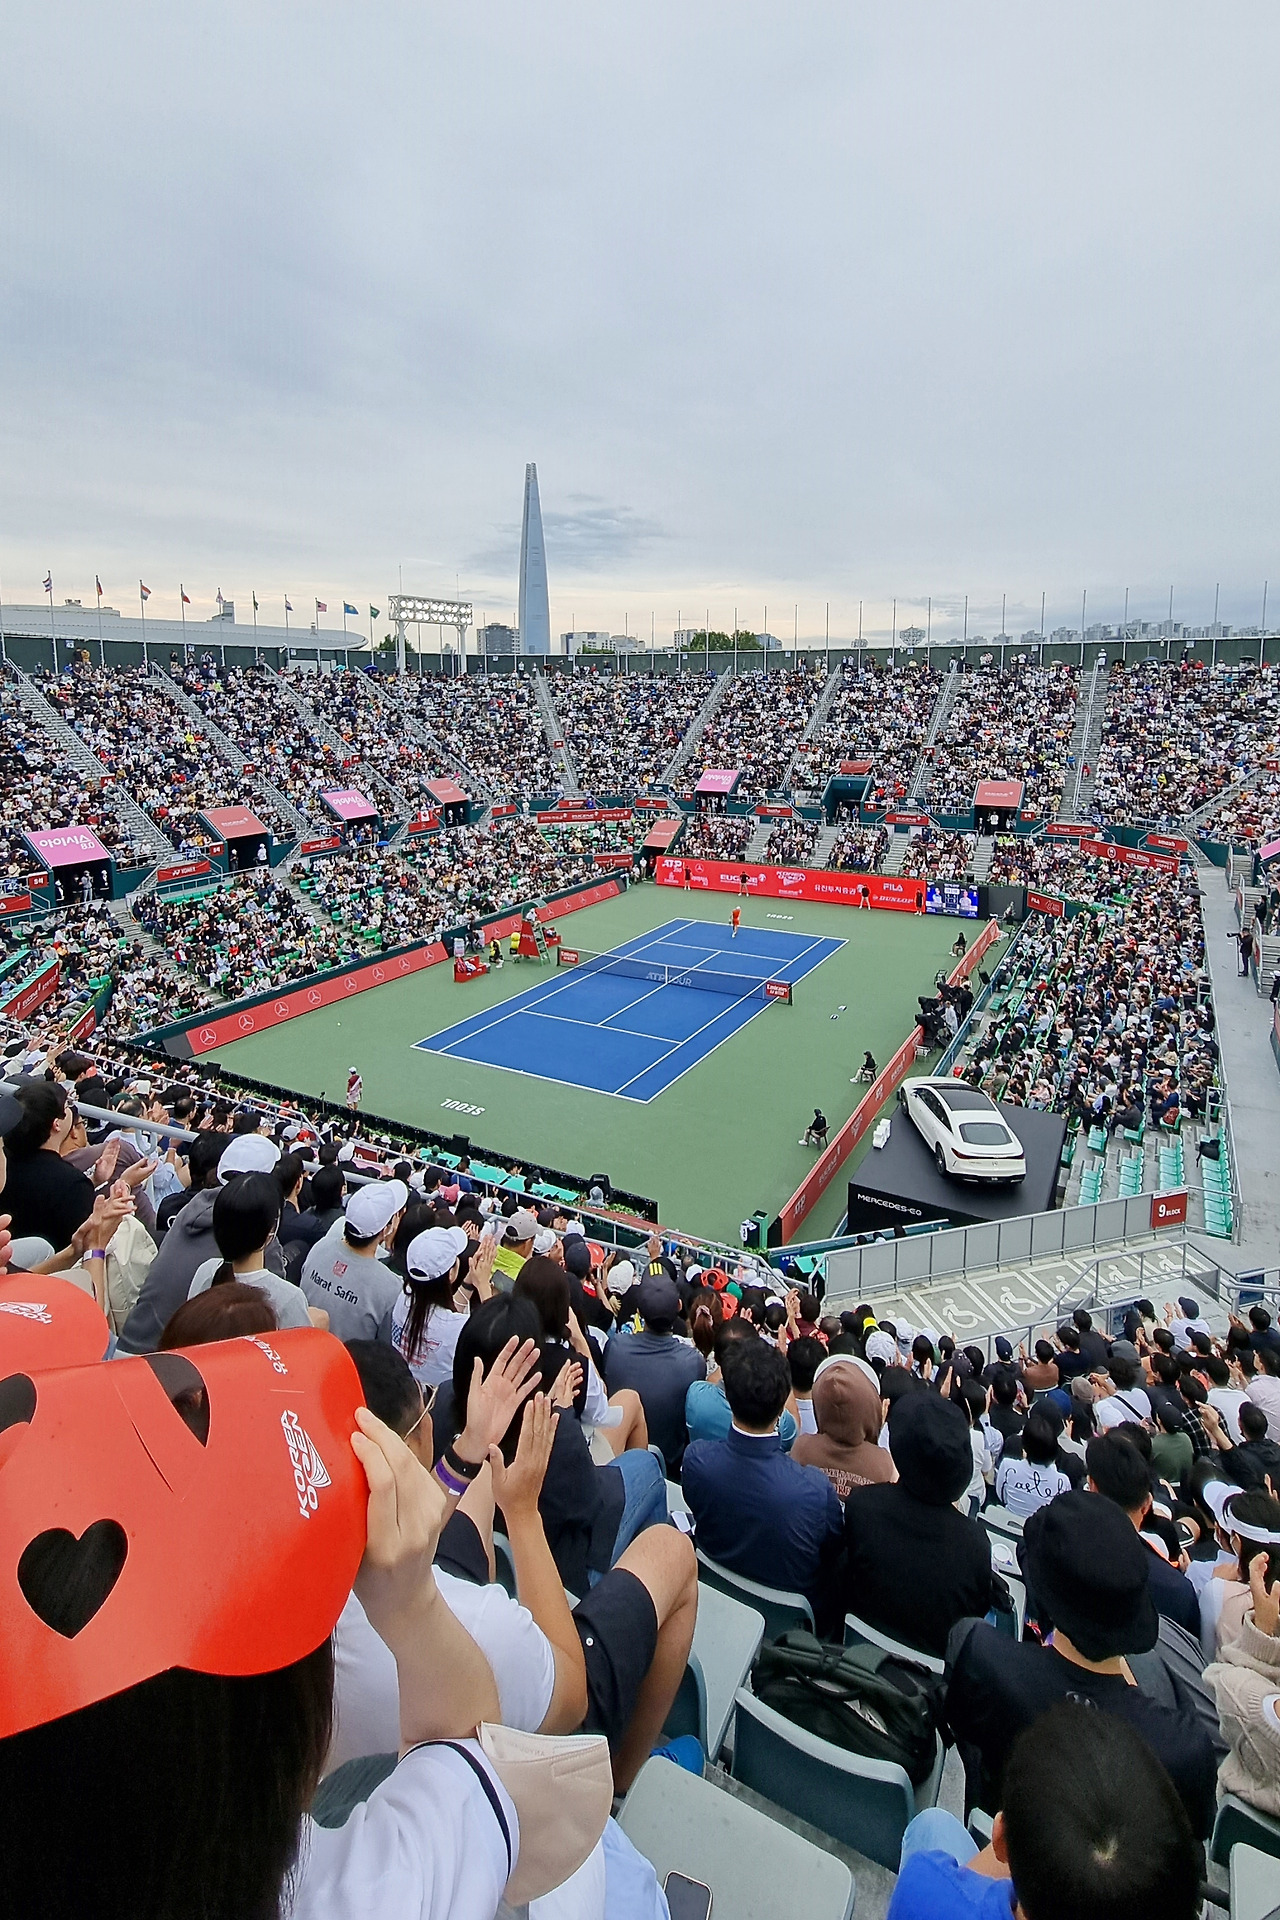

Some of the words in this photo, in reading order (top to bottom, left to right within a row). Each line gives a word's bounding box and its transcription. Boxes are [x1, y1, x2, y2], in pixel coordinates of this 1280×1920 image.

[882, 882, 904, 892] FILA
[879, 895, 914, 904] DUNLOP
[440, 1098, 486, 1116] SEOUL
[857, 1193, 923, 1217] MERCEDES-EQ
[1158, 1204, 1166, 1218] 9
[310, 1269, 332, 1292] Marat
[334, 1285, 359, 1305] Safin
[280, 1409, 311, 1519] KOREA
[287, 1409, 319, 1511] OPEN
